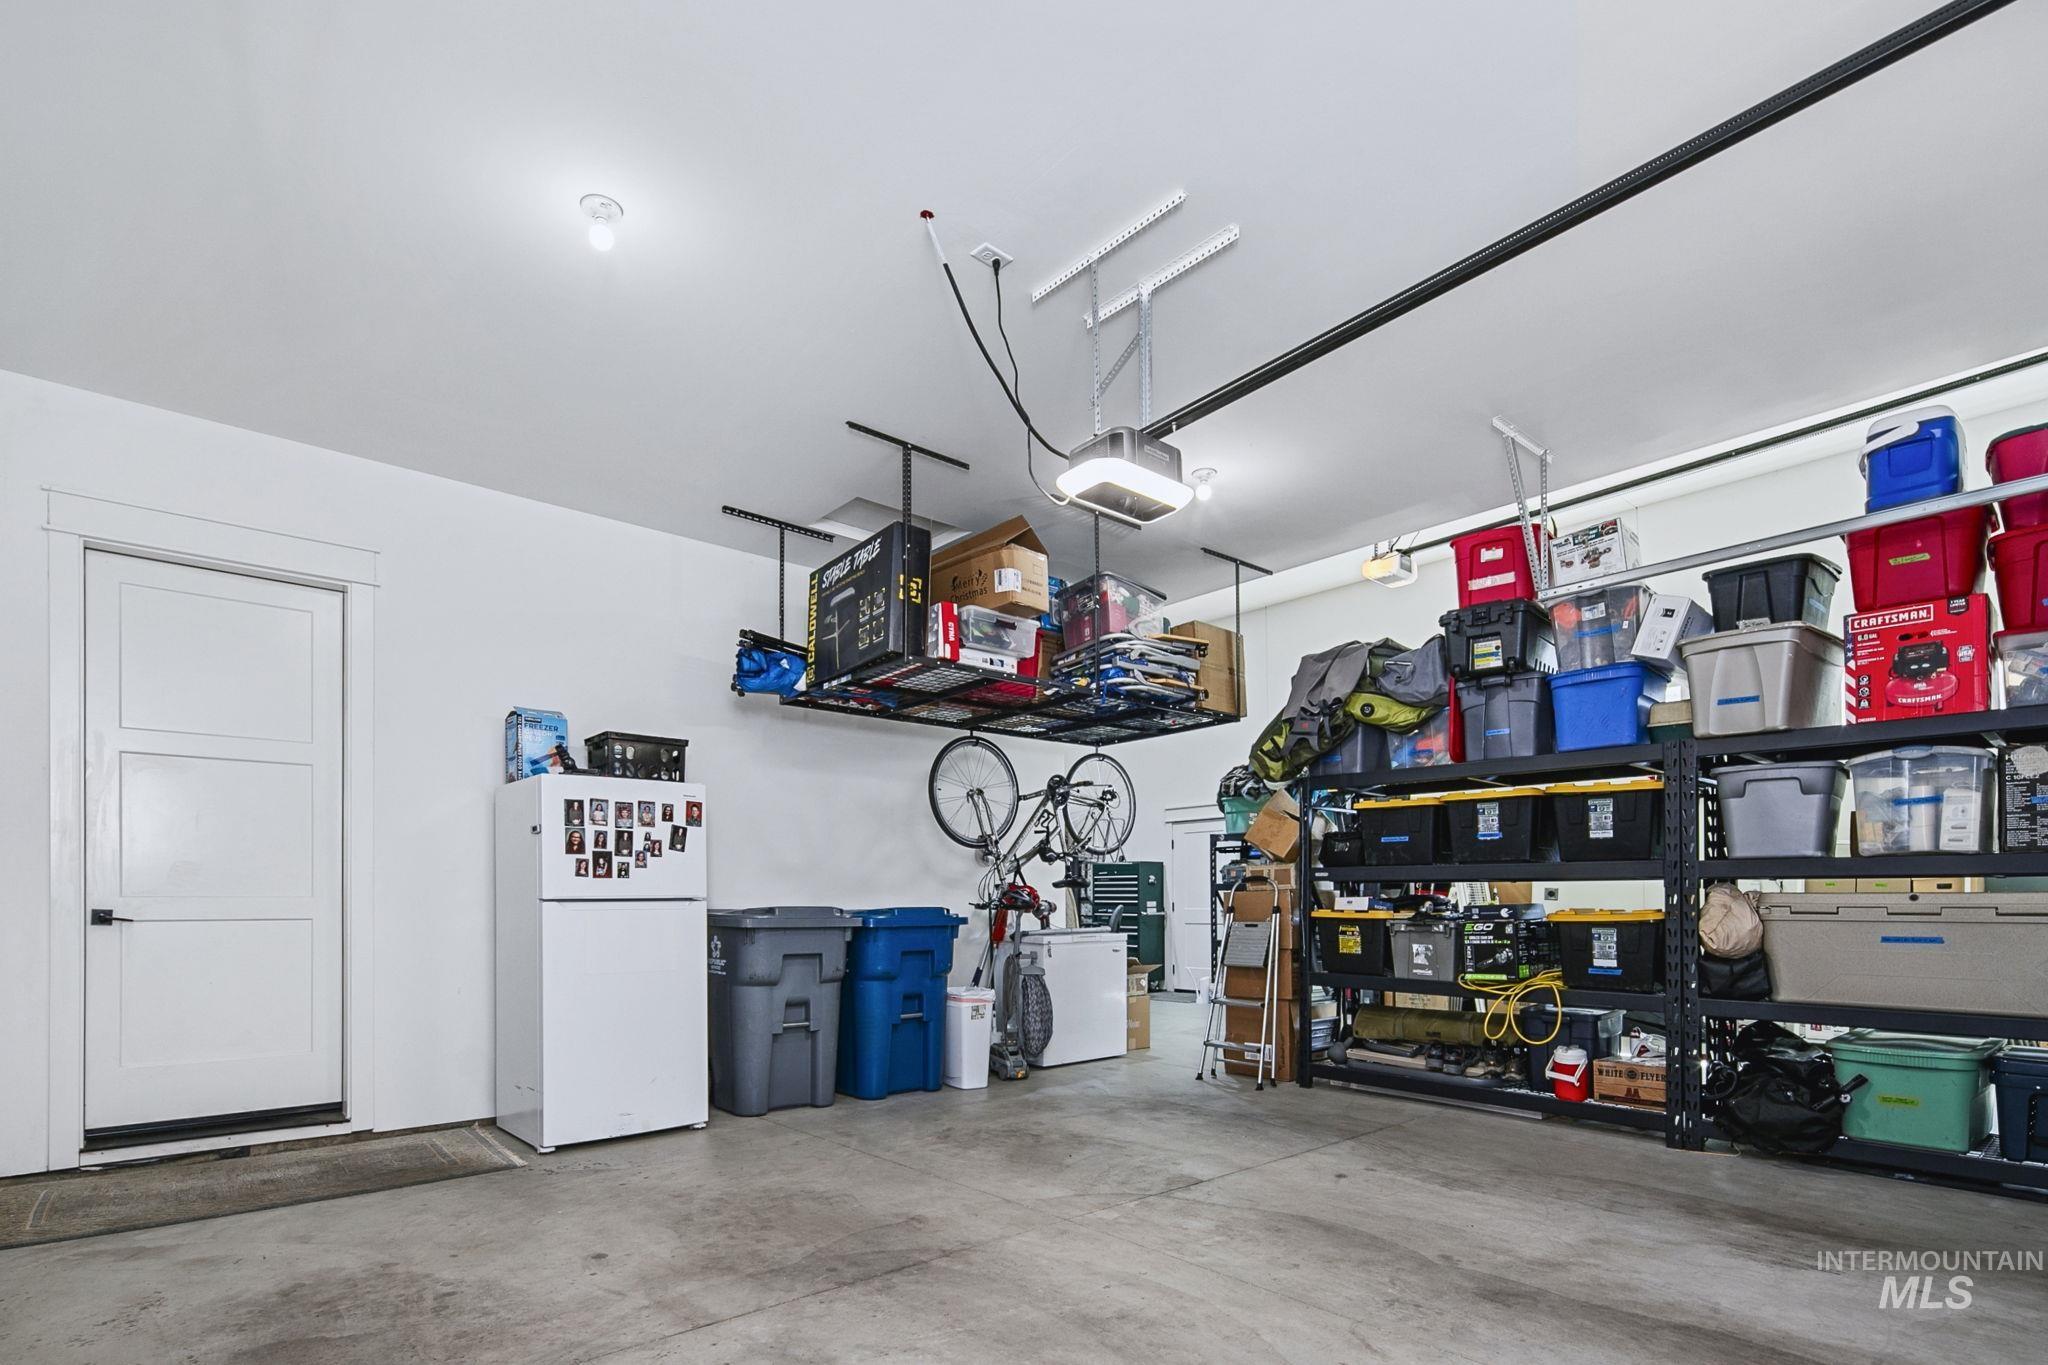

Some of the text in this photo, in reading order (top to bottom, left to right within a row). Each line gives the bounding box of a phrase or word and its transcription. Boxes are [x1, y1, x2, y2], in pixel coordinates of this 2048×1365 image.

[822, 556, 852, 588] STABLE
[853, 536, 882, 570] TABLE
[808, 573, 819, 664] CALDWELL
[1853, 608, 1928, 629] CRAFTSMAN
[1898, 694, 1942, 703] CRAFTSMAN
[524, 723, 558, 731] FREEZER
[1464, 923, 1494, 931] EGO
[1597, 1067, 1623, 1078] WHITE
